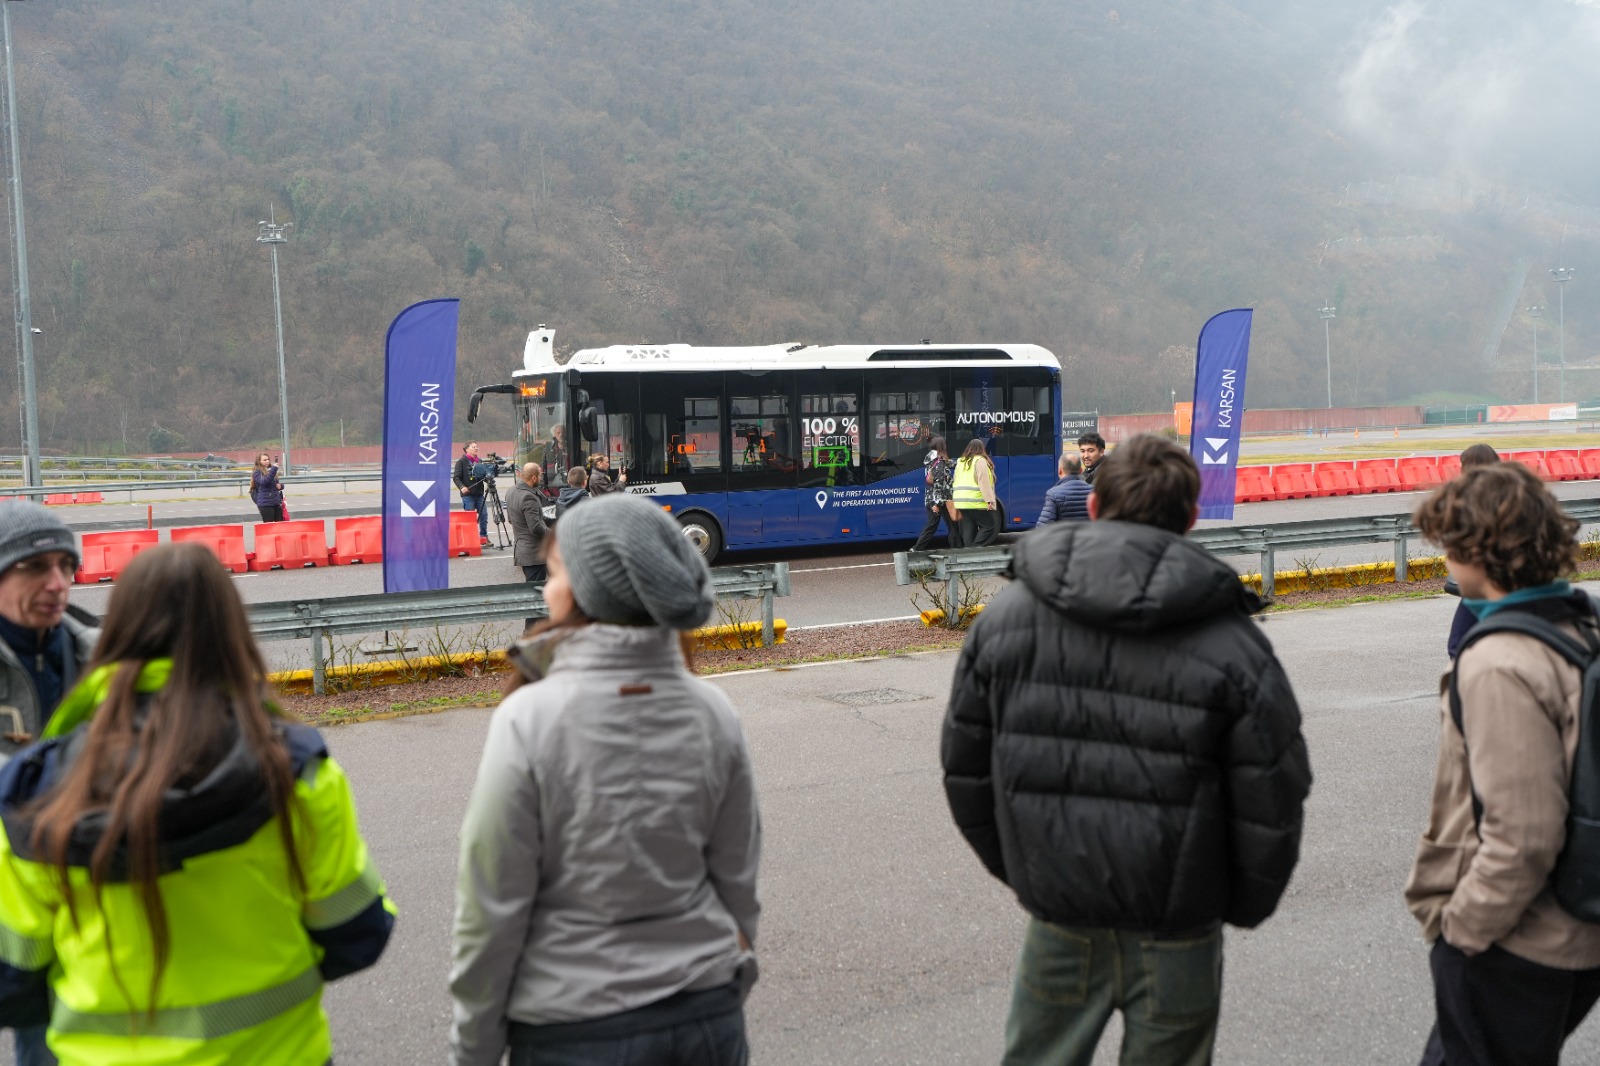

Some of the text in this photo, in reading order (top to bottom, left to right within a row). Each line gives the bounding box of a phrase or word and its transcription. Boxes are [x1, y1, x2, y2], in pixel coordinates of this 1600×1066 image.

[1218, 369, 1237, 428] KARSAN
[419, 383, 440, 465] KARSAN
[956, 411, 1036, 424] AUTONOMOUS
[802, 417, 858, 435] 100 %
[803, 435, 859, 447] ELECTRIC
[845, 490, 862, 498] FIRST
[862, 487, 906, 497] AUTONOMOUS
[841, 499, 876, 508] OPERATION
[885, 497, 912, 505] NORWAY
